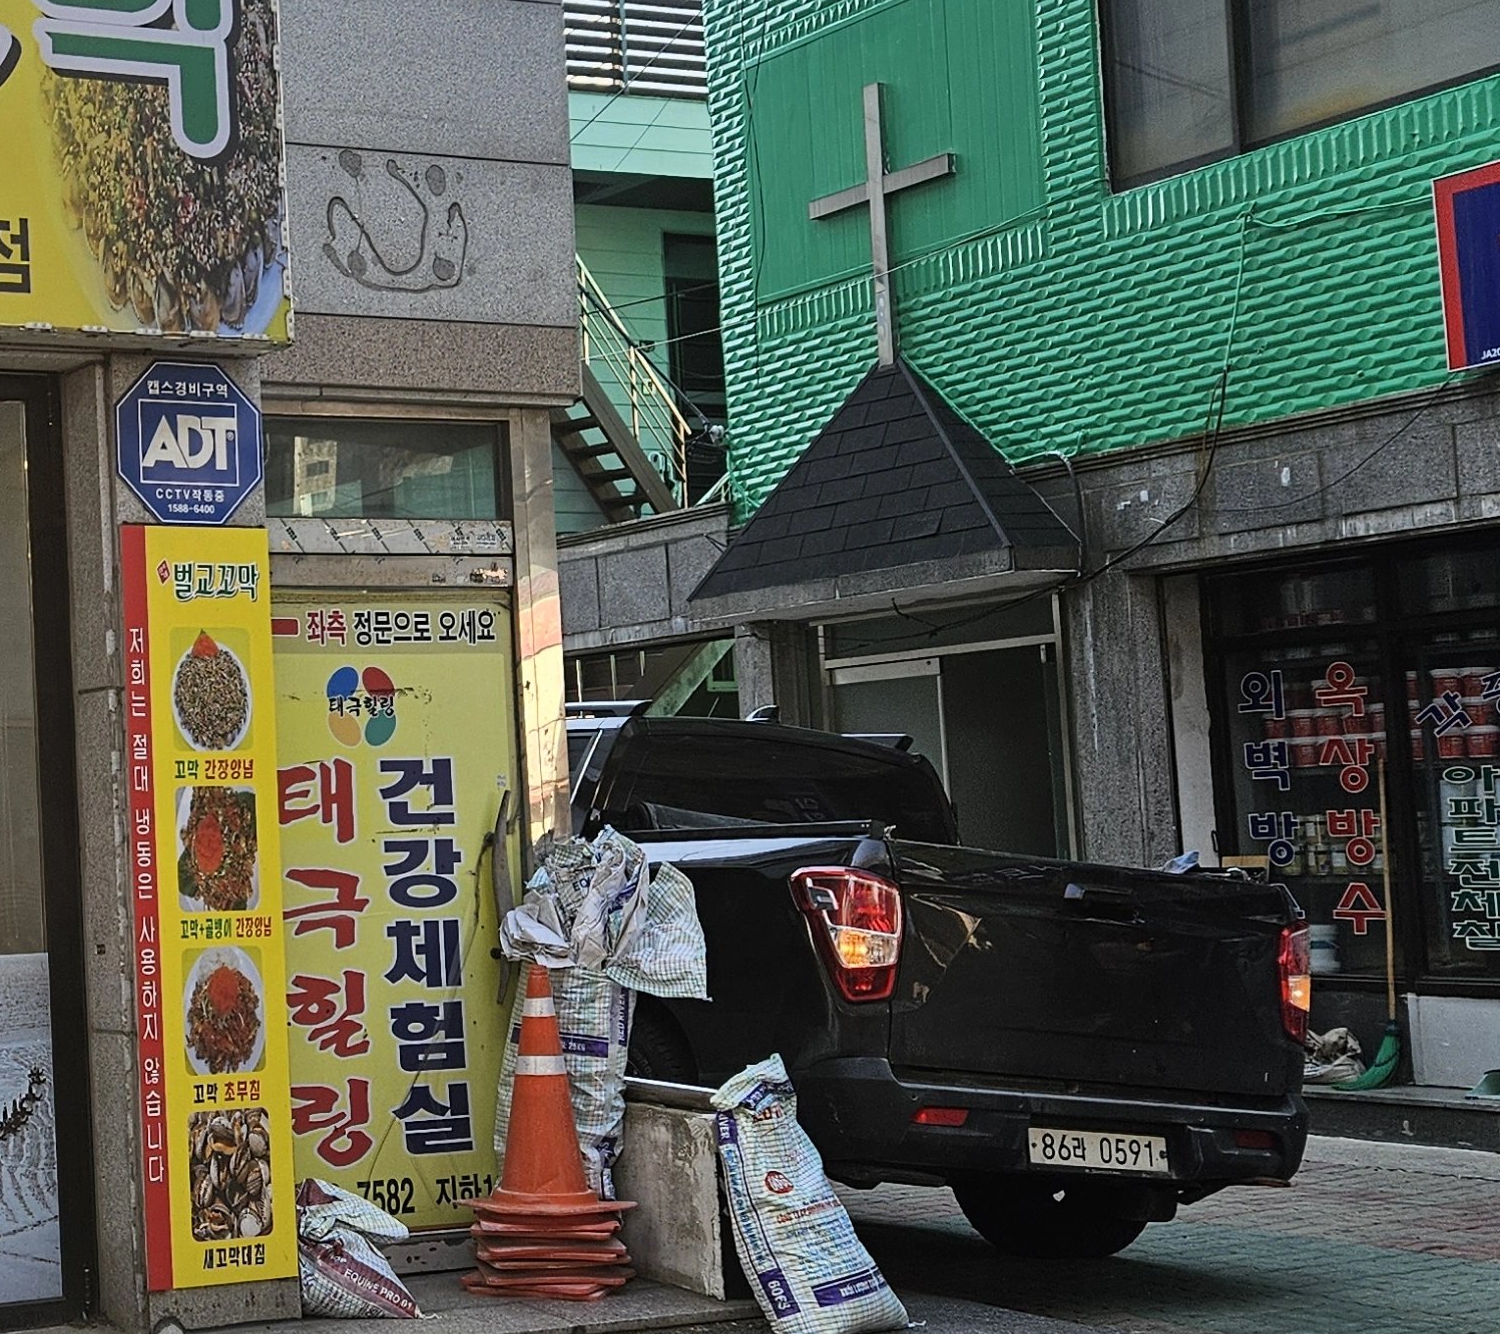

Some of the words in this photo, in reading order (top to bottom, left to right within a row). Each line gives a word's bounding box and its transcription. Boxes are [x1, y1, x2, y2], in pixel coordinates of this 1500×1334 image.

[147, 380, 229, 398] 캡스경비구역
[142, 414, 236, 471] ADT
[155, 488, 225, 503] CCTV작동중
[167, 503, 216, 515] 1588-6400
[173, 560, 260, 602] 벌교꼬막
[306, 610, 347, 645] 좌측
[353, 610, 432, 646] 정문으로
[438, 608, 497, 643] 오세요
[129, 627, 147, 718] 저희는
[329, 695, 396, 718] 태극힐링
[132, 732, 150, 793] 절대
[175, 760, 199, 779] 꼬막
[204, 759, 254, 780] 간장양념
[1316, 661, 1387, 935] 옥상방수
[135, 808, 153, 900] 냉동은
[236, 916, 272, 938] 간장양념
[277, 758, 373, 1168] 태극힐링
[380, 758, 475, 1156] 건강체험실
[139, 915, 159, 1042] 사용하지
[193, 1083, 219, 1104] 꼬막
[224, 1080, 261, 1102] 초무침
[143, 1057, 166, 1184] 않습니다
[1042, 1132, 1087, 1161] 86라
[1099, 1137, 1154, 1167] 0591
[436, 1174, 499, 1209] 지하1
[203, 1243, 266, 1271] 새꼬막데침
[344, 1268, 380, 1294] EQUINE
[380, 1286, 401, 1305] PRO
